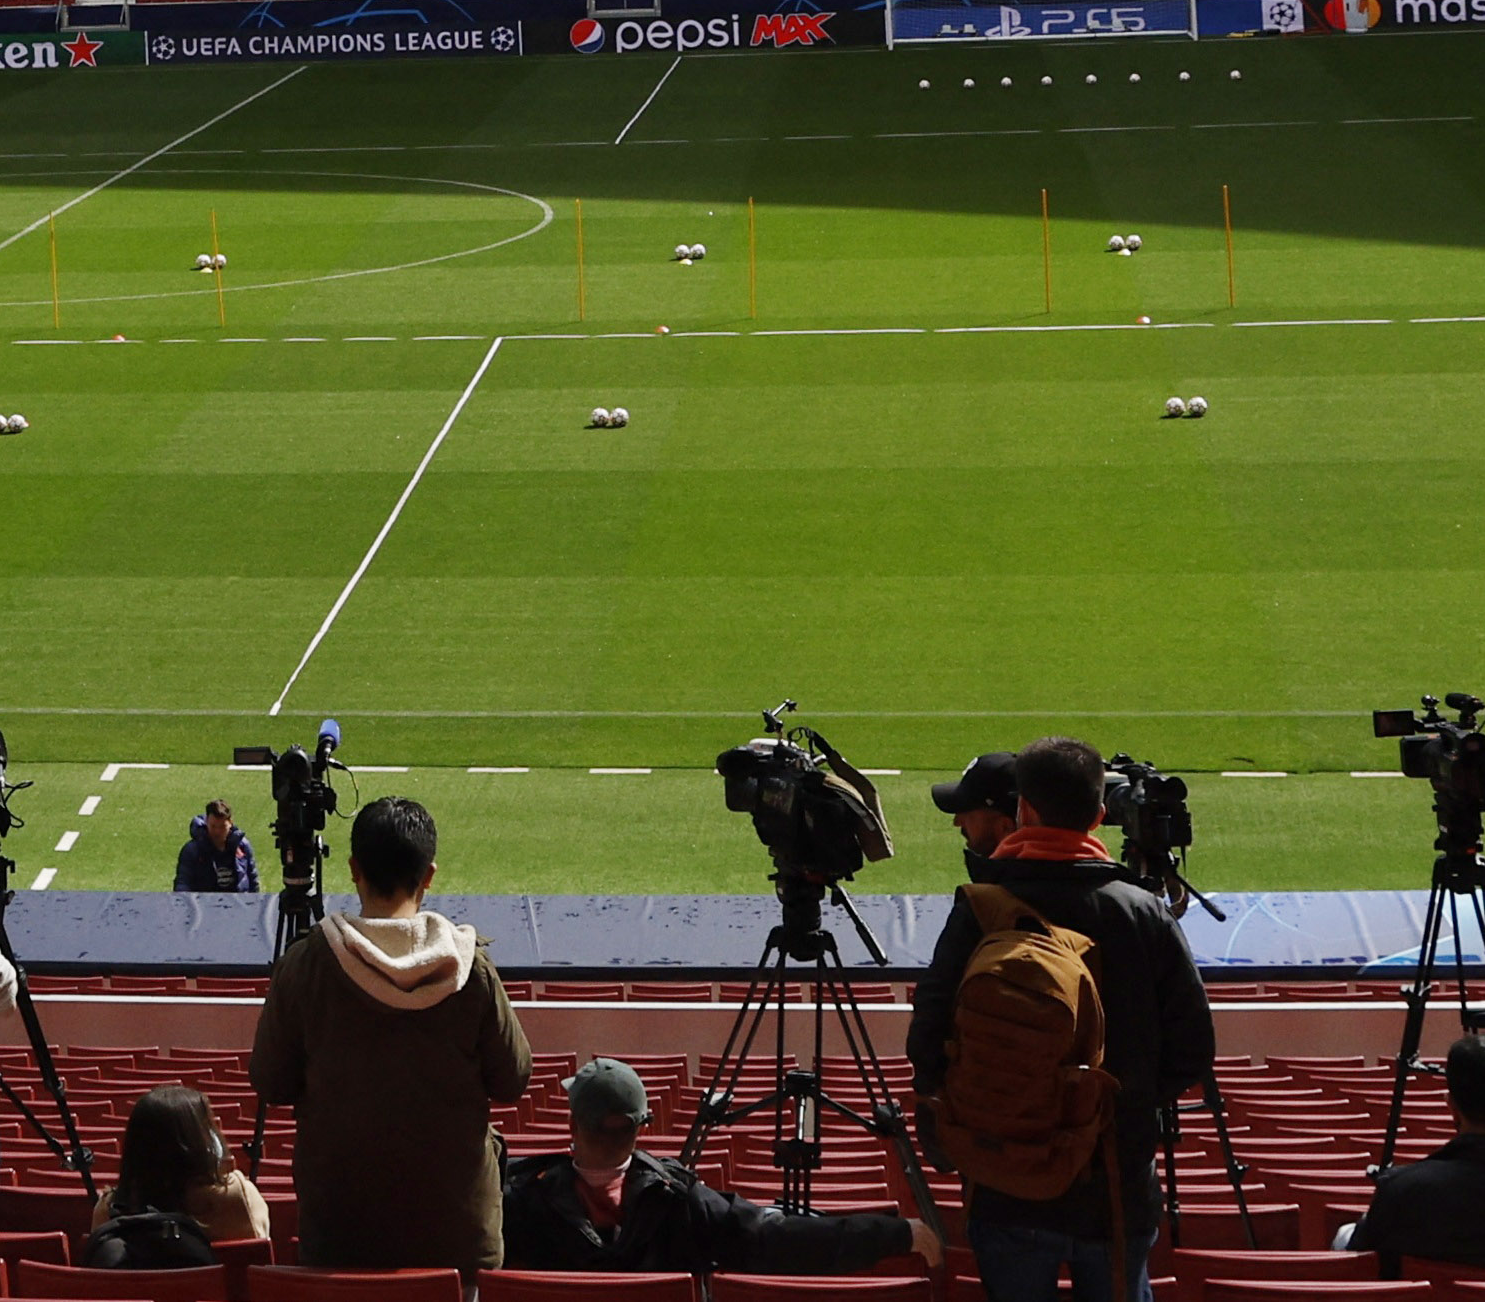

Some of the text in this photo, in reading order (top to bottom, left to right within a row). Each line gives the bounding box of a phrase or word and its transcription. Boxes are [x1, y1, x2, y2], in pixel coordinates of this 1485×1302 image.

[616, 11, 836, 53] pepsi MAX
[1041, 7, 1146, 34] PS5
[182, 29, 485, 57] UEFA CHAMPIONS LEAGUE
